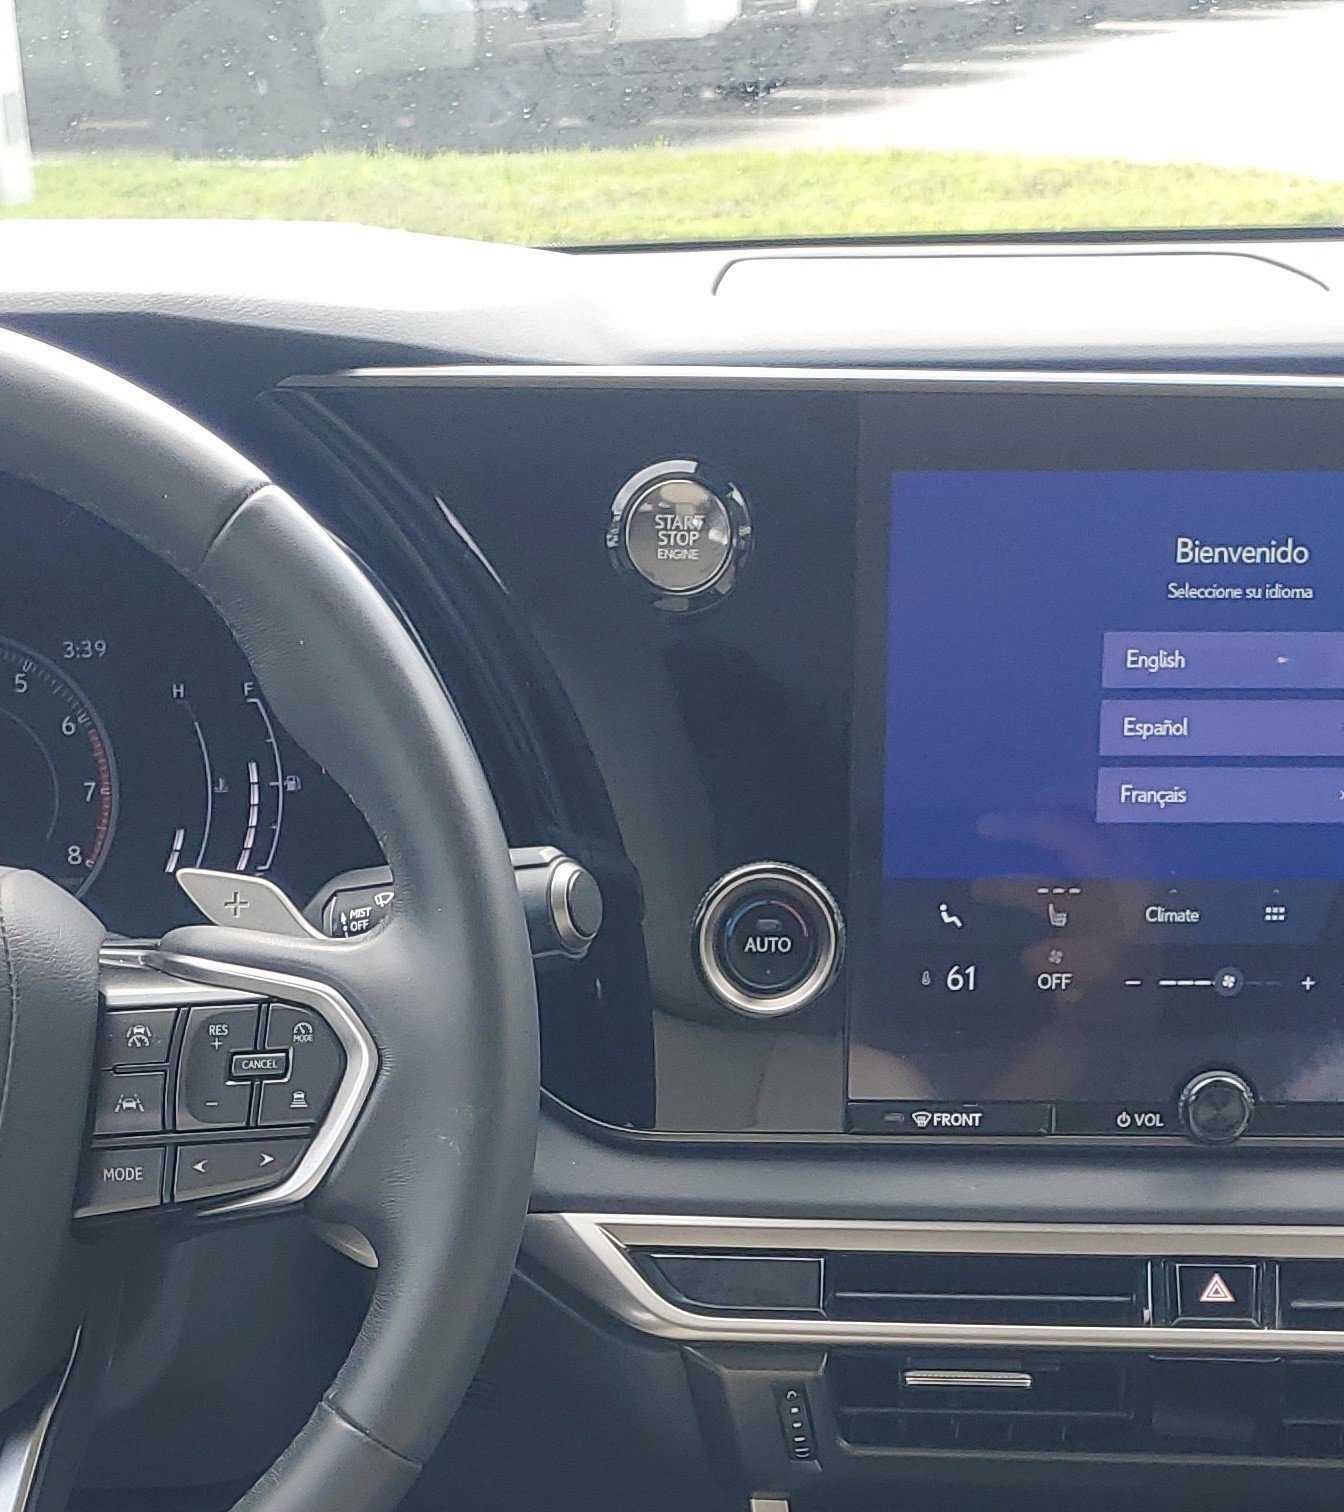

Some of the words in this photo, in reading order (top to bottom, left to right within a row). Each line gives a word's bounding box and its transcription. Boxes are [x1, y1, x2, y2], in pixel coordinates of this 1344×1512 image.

[655, 514, 706, 530] START
[658, 531, 700, 546] STOP
[657, 549, 700, 560] ENGINE
[1175, 537, 1309, 564] Bienvenido
[1167, 583, 1243, 599] Seleccione
[1245, 587, 1262, 599] su
[1265, 583, 1314, 599] idioma
[62, 640, 107, 659] 3:39
[1126, 649, 1187, 672] English
[14, 673, 28, 693] 5
[171, 683, 185, 698] H
[61, 716, 76, 736] 6
[1123, 716, 1189, 740] Español
[83, 782, 97, 801] 7
[1119, 784, 1188, 808] Français
[67, 845, 82, 865] 8
[349, 907, 373, 920] MIST
[1145, 906, 1201, 924] Climate
[349, 919, 369, 931] OFF
[744, 937, 792, 953] AUTO
[946, 965, 976, 991] 61
[1037, 973, 1073, 990] OFF
[209, 1024, 229, 1036] RES
[293, 1034, 313, 1043] MODE
[241, 1060, 278, 1070] CANCEL
[933, 1112, 983, 1127] FRONT
[1134, 1113, 1164, 1127] VOL
[103, 1167, 144, 1181] MODE
